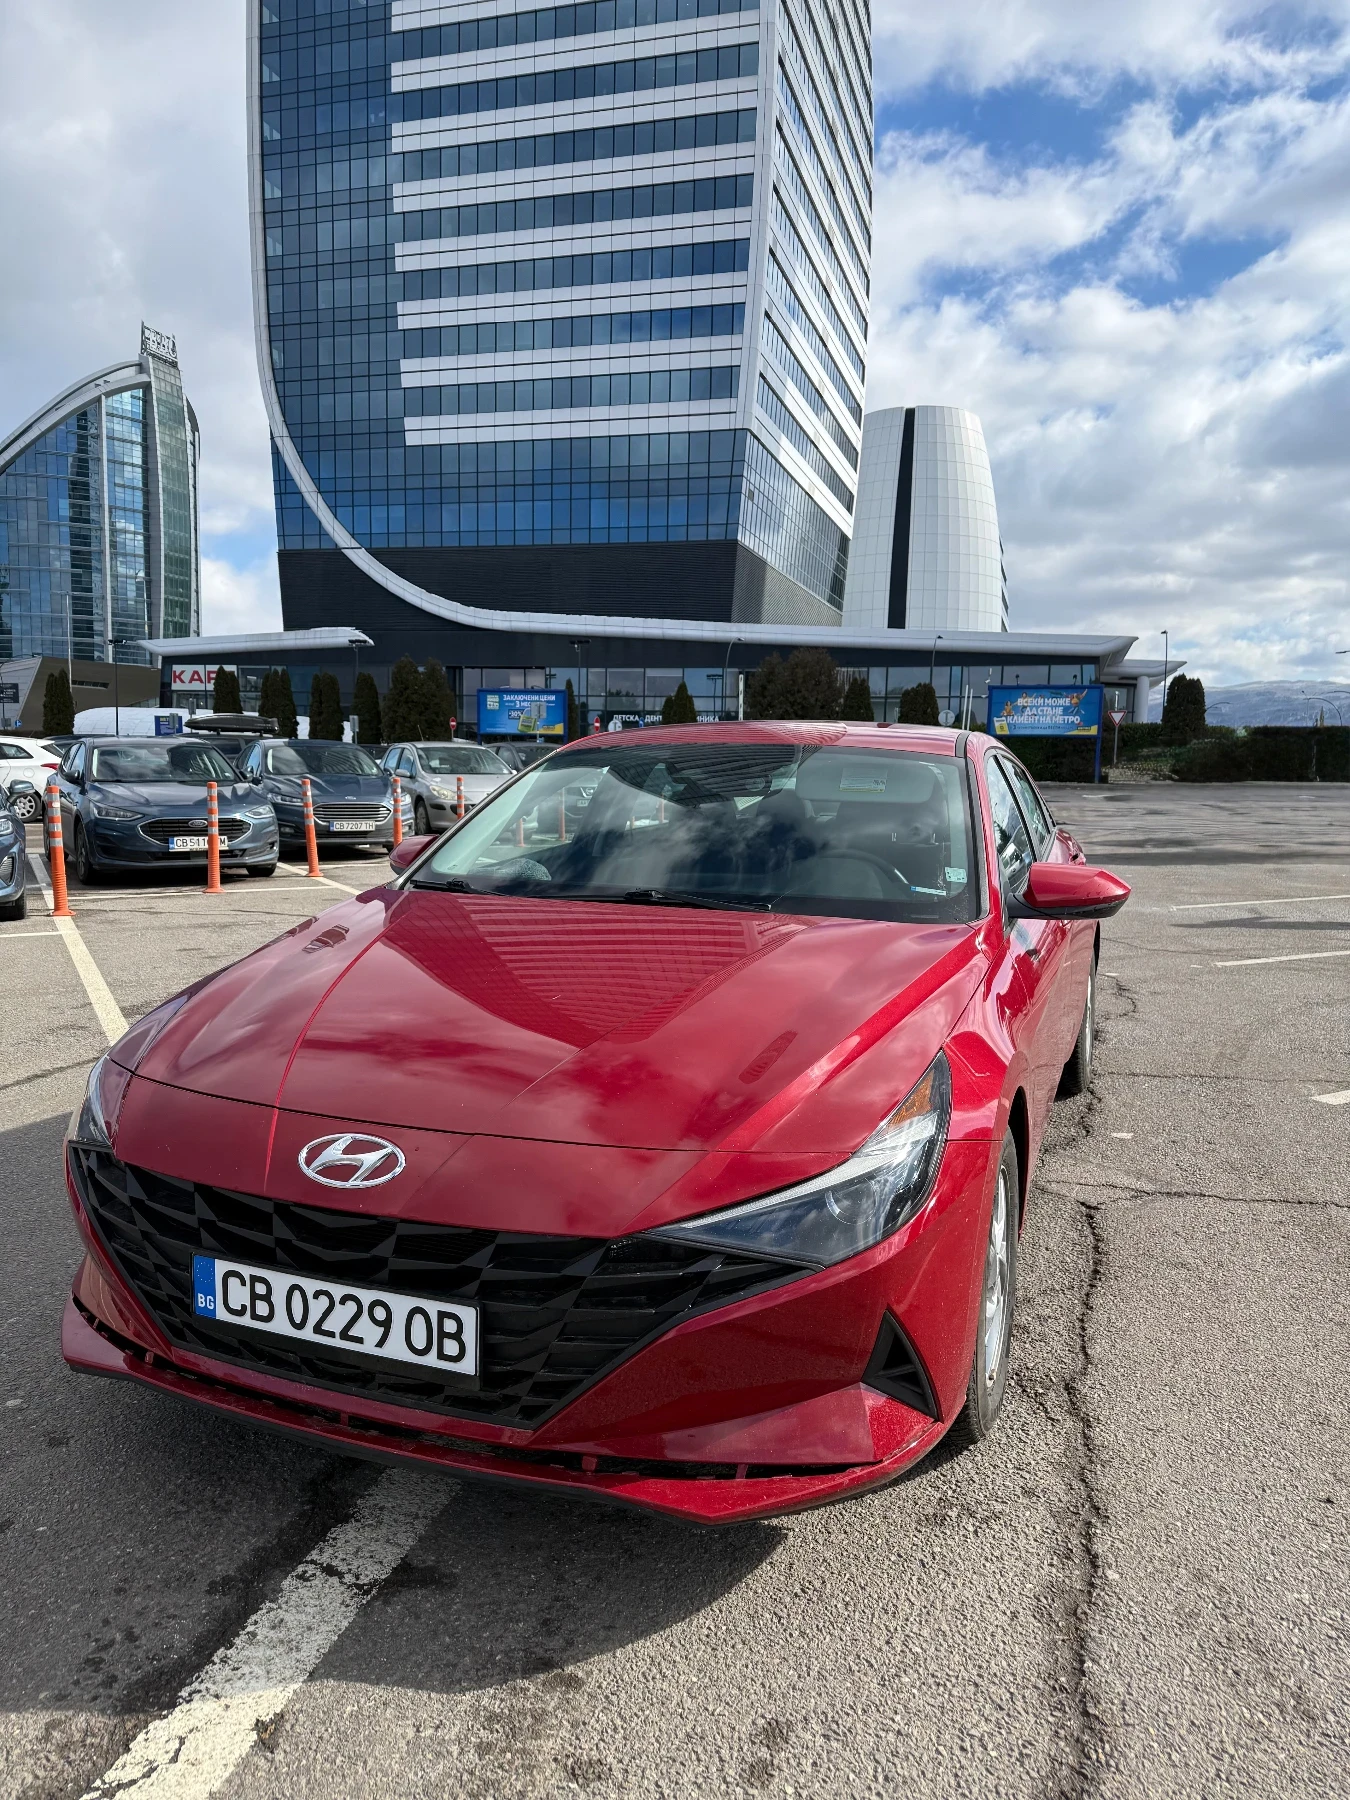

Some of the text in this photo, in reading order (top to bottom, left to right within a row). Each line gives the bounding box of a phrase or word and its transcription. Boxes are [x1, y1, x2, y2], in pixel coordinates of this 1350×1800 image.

[1017, 698, 1070, 706] ВСЕКИ МОЖЕ
[1025, 707, 1063, 715] ДА СТАНЕ
[1007, 716, 1039, 724] КЛИЕНТ
[1040, 716, 1051, 724] НА
[1052, 716, 1080, 724] МЕТРО
[335, 822, 374, 830] CB 7207 TH
[176, 838, 188, 848] CB
[198, 1269, 467, 1363] BG CB 0229 OB
